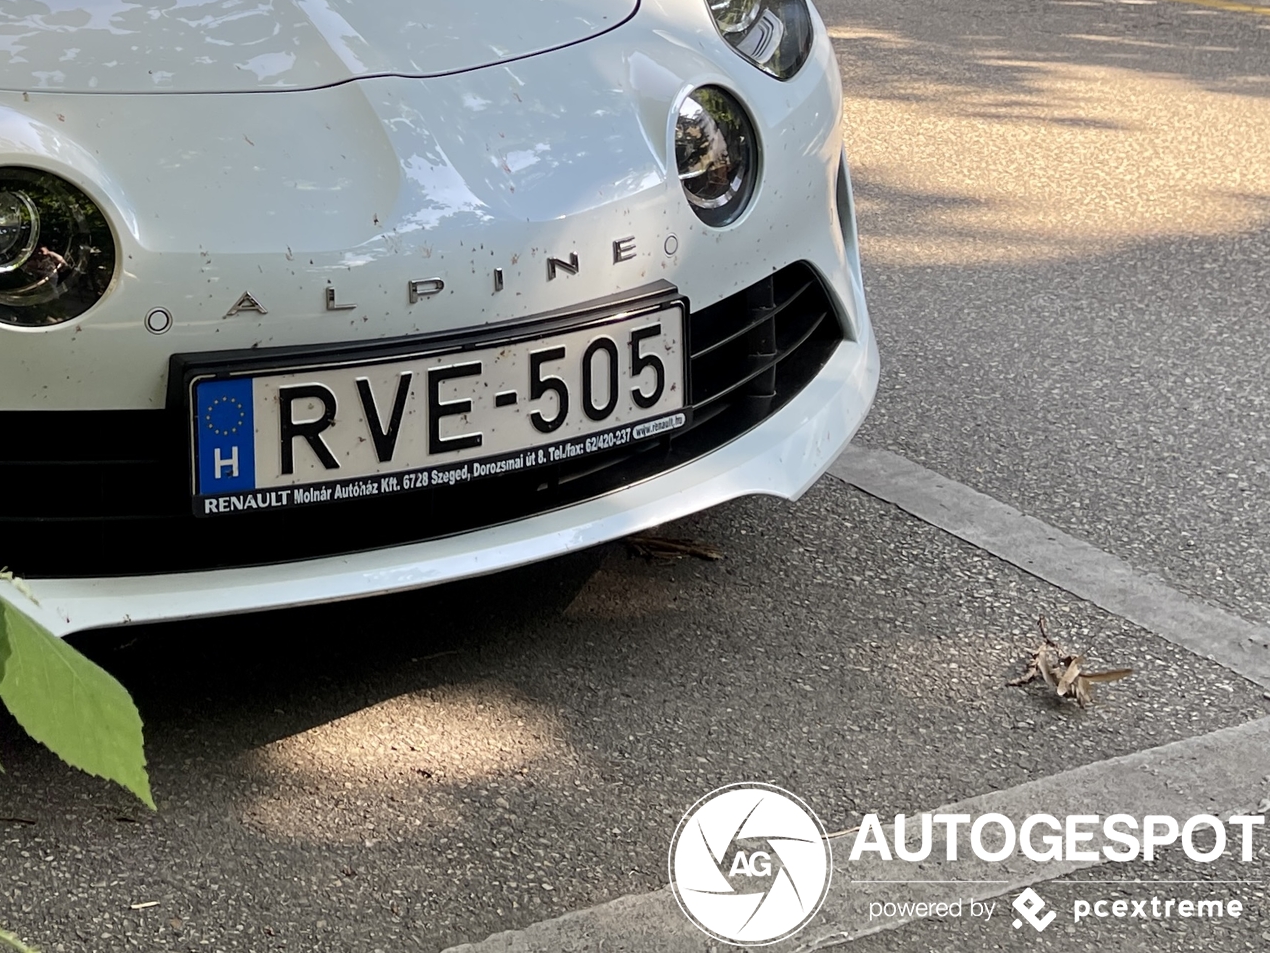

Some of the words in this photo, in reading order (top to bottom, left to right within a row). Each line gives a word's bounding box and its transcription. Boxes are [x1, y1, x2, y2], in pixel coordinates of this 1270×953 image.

[228, 235, 636, 315] ALPINE
[278, 323, 666, 475] RVE-505
[204, 490, 291, 514] RENAULT
[294, 486, 332, 505] Molnár
[334, 481, 379, 500] Autóház
[381, 478, 401, 493] Kft.
[403, 472, 429, 490] 6728
[431, 465, 471, 486] Szeged,
[473, 454, 524, 477] Dorozsmai
[526, 452, 536, 466] út
[538, 450, 547, 464] 8.
[548, 444, 584, 461] Tel./fax:
[585, 428, 632, 453] 62/420-237
[635, 416, 683, 437] www.renault.hu
[214, 446, 239, 479] H
